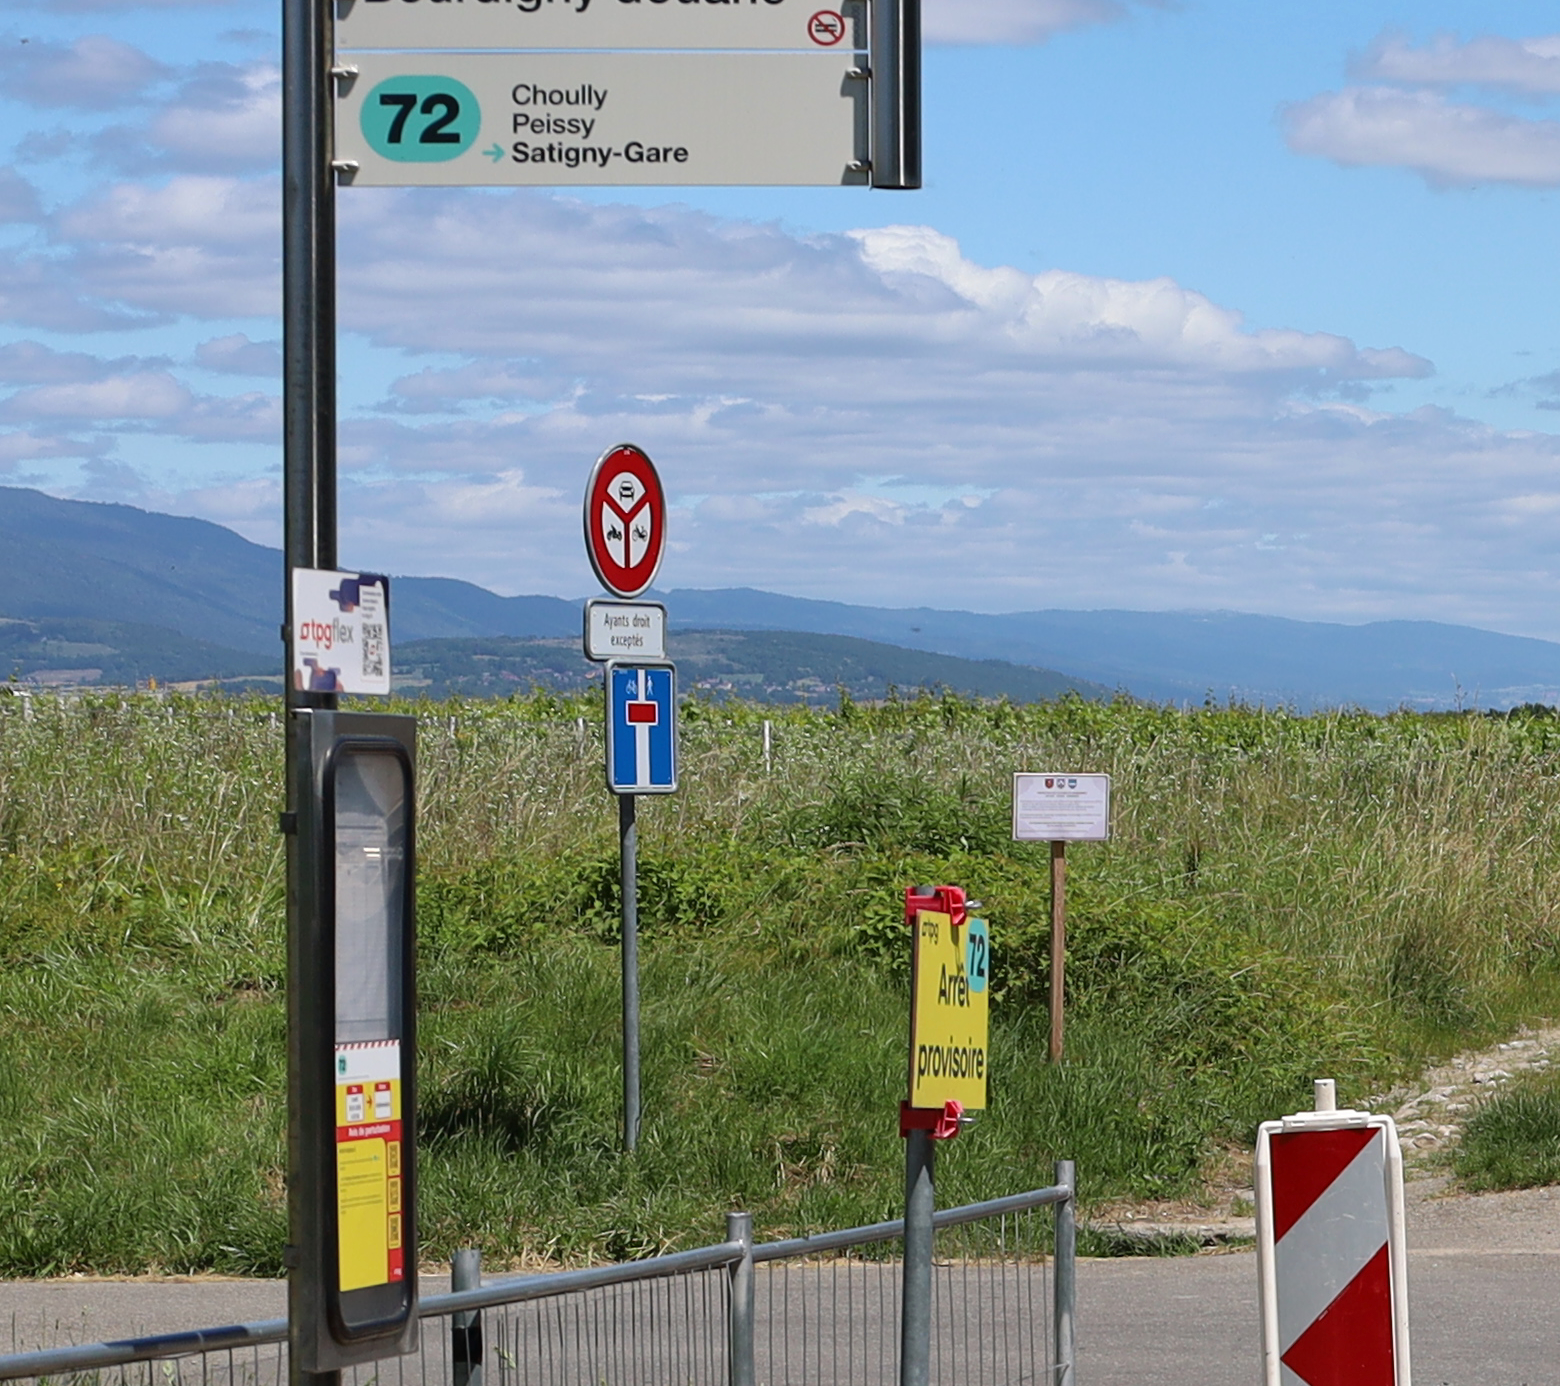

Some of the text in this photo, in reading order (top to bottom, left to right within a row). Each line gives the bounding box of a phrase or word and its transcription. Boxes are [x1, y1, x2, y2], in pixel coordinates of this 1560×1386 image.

[511, 83, 609, 112] Choully
[378, 93, 461, 145] 72
[511, 113, 596, 140] Peissy
[511, 142, 690, 168] Satigny-Gare
[603, 612, 651, 630] Ayants droit
[969, 932, 985, 978] 72
[938, 963, 970, 1008] Arrêt
[917, 1035, 984, 1090] provisoire
